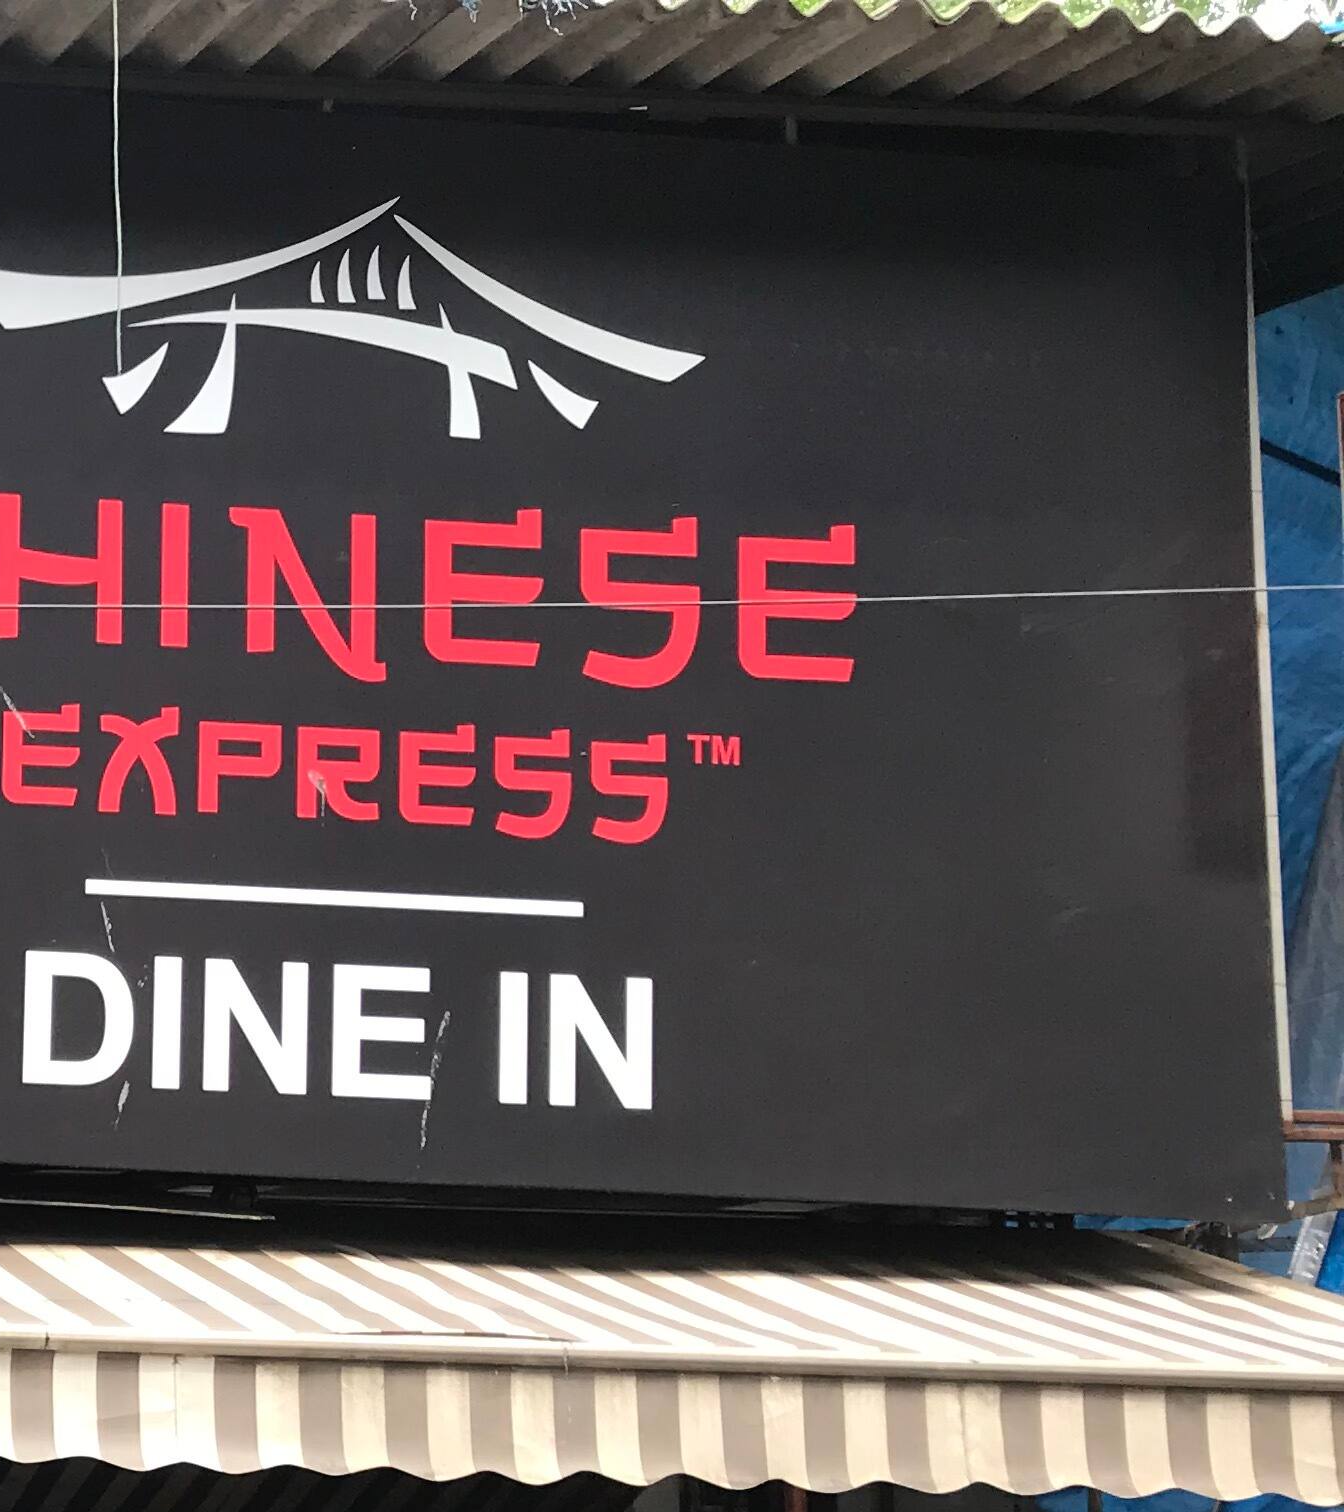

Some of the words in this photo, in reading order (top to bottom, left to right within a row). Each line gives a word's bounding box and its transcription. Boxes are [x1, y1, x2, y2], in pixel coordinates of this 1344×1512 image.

[0, 703, 669, 845] EXPRESS
[686, 733, 741, 766] TM
[21, 949, 432, 1101] DINE
[498, 970, 654, 1110] IN
